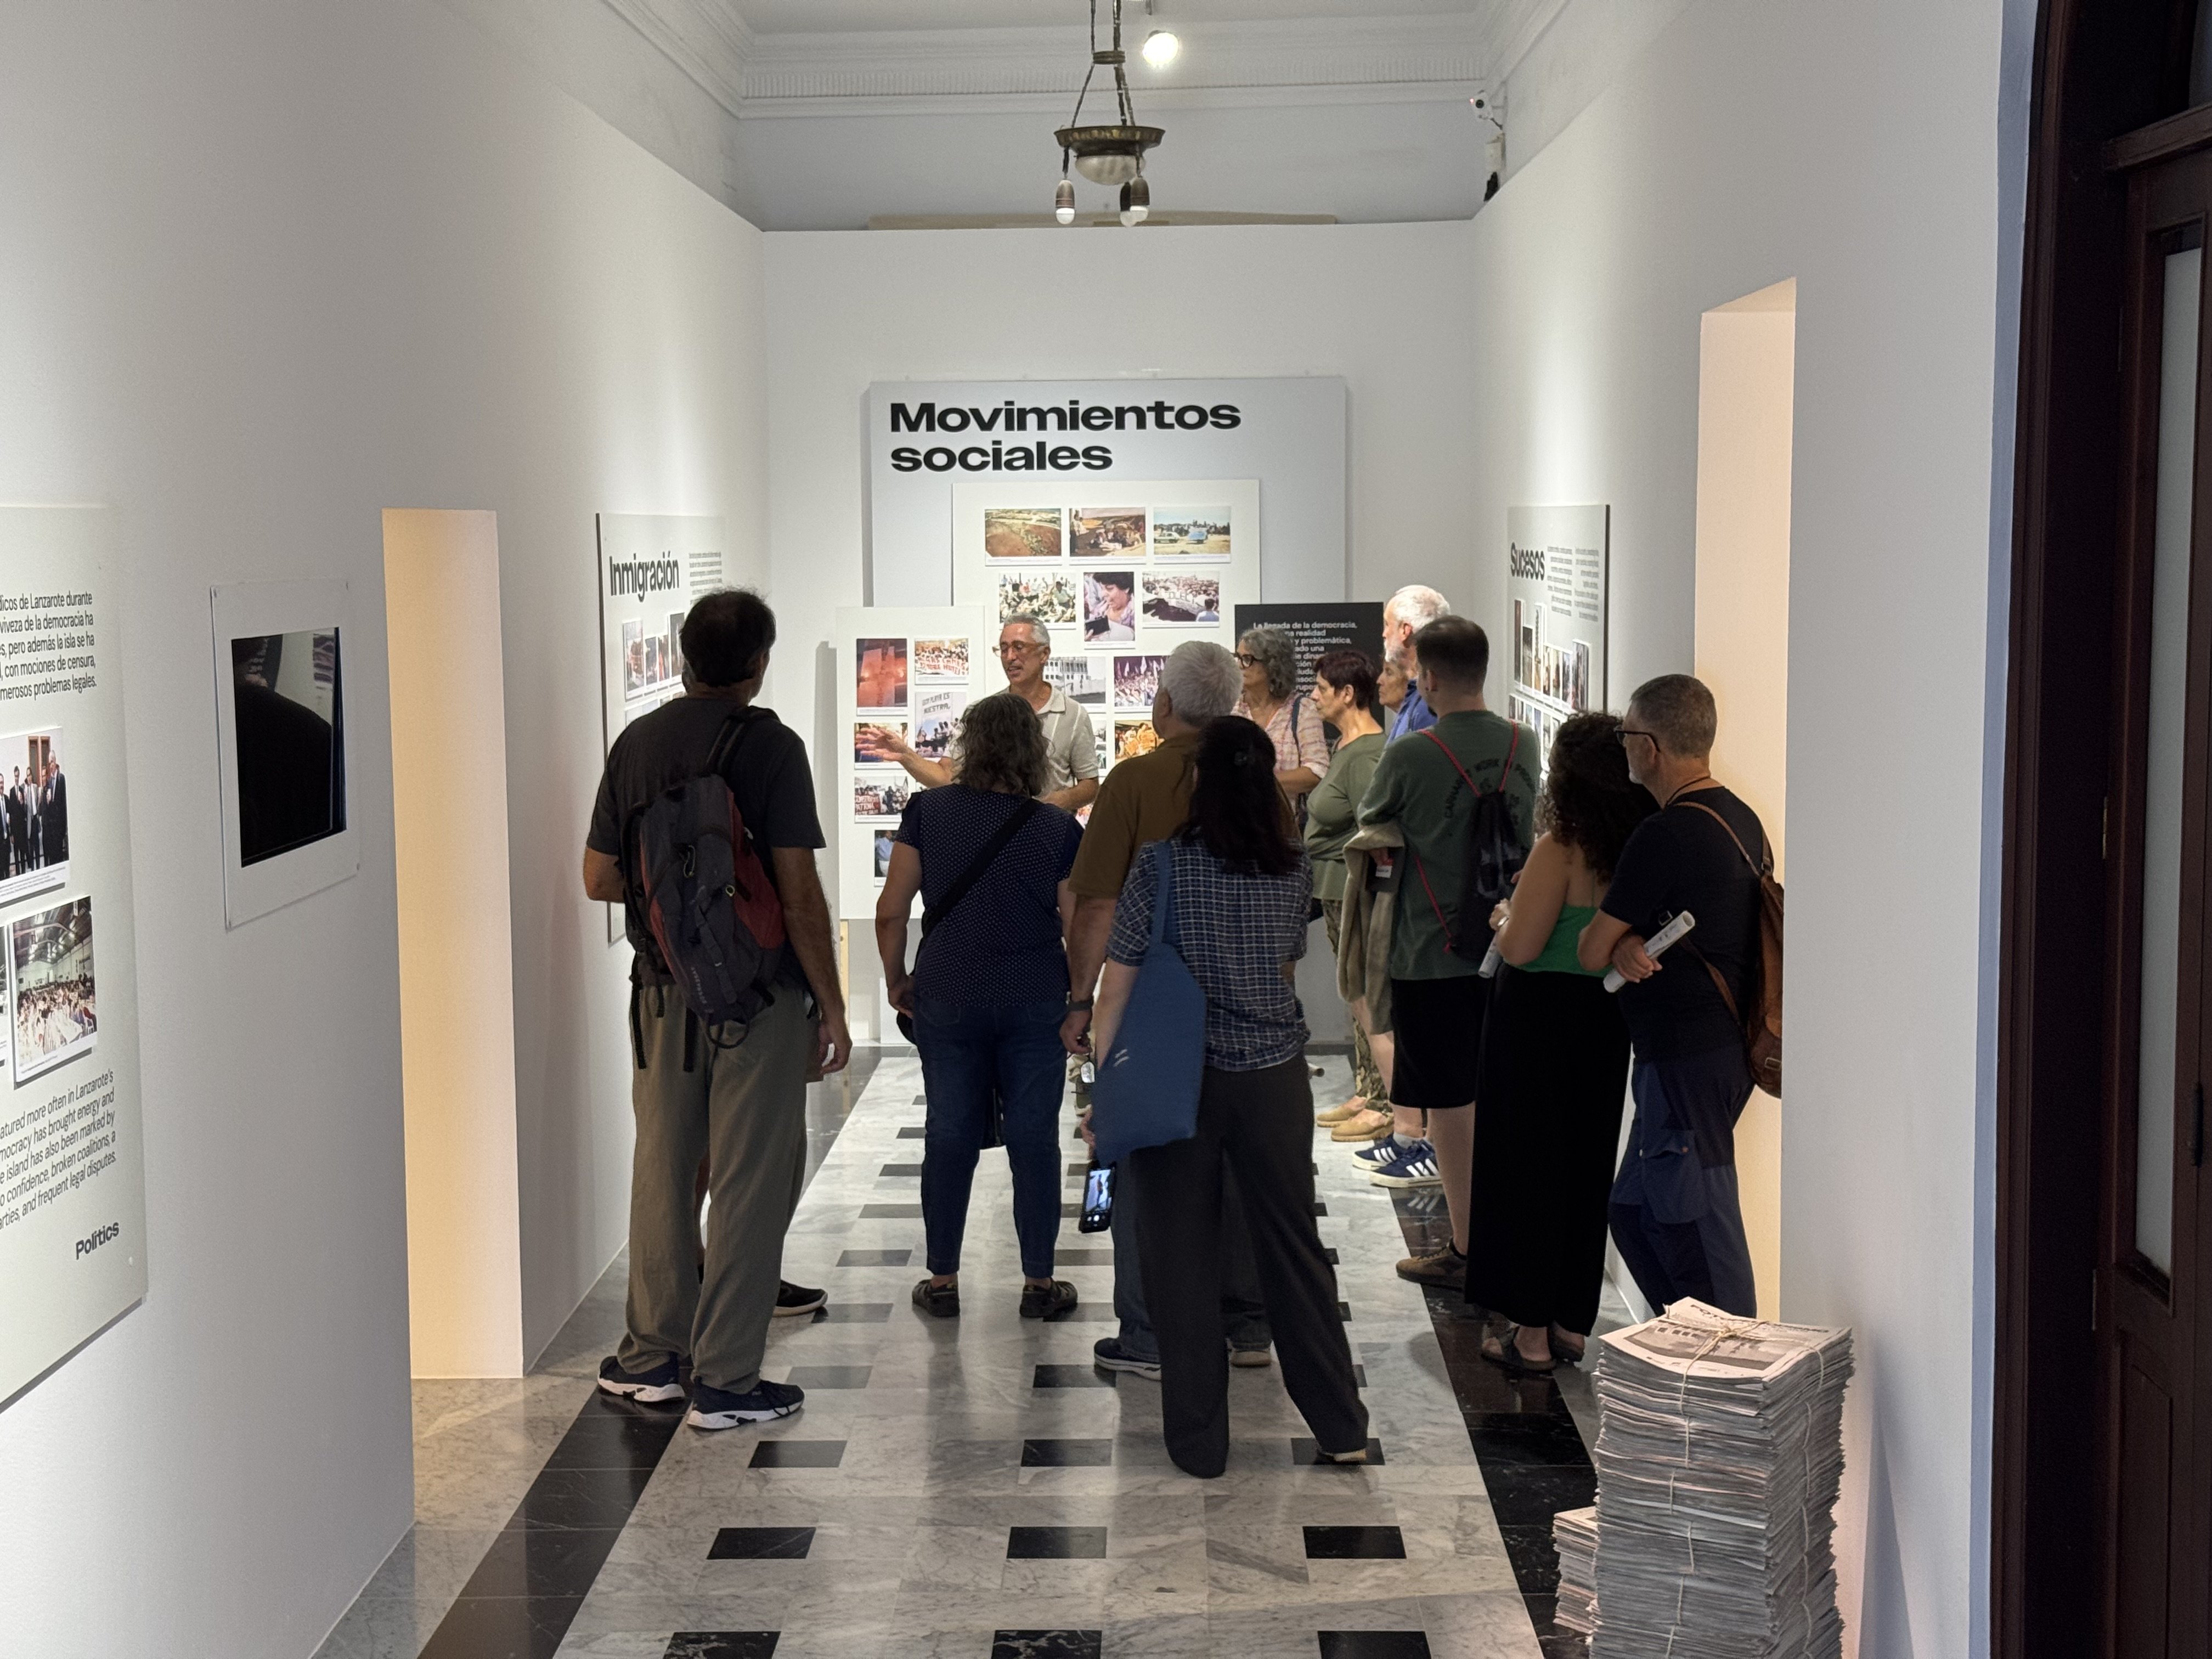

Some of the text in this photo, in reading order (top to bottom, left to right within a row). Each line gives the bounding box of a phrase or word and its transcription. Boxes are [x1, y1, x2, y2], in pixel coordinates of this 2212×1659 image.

[890, 400, 1241, 432] Movimientos
[890, 441, 1113, 472] sociales
[609, 551, 680, 602] Inmigración
[1510, 542, 1545, 580] Sucesos
[19, 592, 29, 610] de
[31, 592, 65, 609] Lanzarote
[66, 590, 93, 606] durante
[25, 614, 33, 631] de
[35, 614, 42, 630] la
[43, 611, 84, 629] democracia
[84, 610, 94, 626] ha
[8, 642, 25, 660] pero
[27, 634, 55, 653] además
[57, 633, 63, 650] la
[64, 632, 76, 648] isla
[77, 635, 85, 647] se
[86, 630, 95, 646] ha
[5, 664, 19, 678] con
[20, 657, 55, 675] mociones
[57, 654, 66, 671] de
[67, 655, 96, 668] censura,
[34, 677, 71, 701] problemas
[72, 672, 97, 693] legales.
[27, 1105, 46, 1125] more
[48, 1096, 66, 1114] often
[67, 1088, 75, 1104] in
[76, 1068, 114, 1101] Lanzarote's
[34, 1127, 47, 1144] has
[48, 1108, 76, 1136] brought
[77, 1097, 100, 1120] energy
[101, 1086, 115, 1107] and
[7, 1153, 28, 1181] island
[30, 1150, 43, 1168] has
[45, 1141, 60, 1160] also
[61, 1130, 78, 1150] been
[80, 1111, 105, 1140] marked
[106, 1109, 115, 1127] by
[7, 1169, 49, 1203] confidence,
[51, 1154, 76, 1177] broken
[111, 1131, 116, 1143] a
[22, 1193, 36, 1217] and
[38, 1176, 69, 1207] frequent
[70, 1164, 86, 1189] legal
[76, 1222, 120, 1260] Politics
